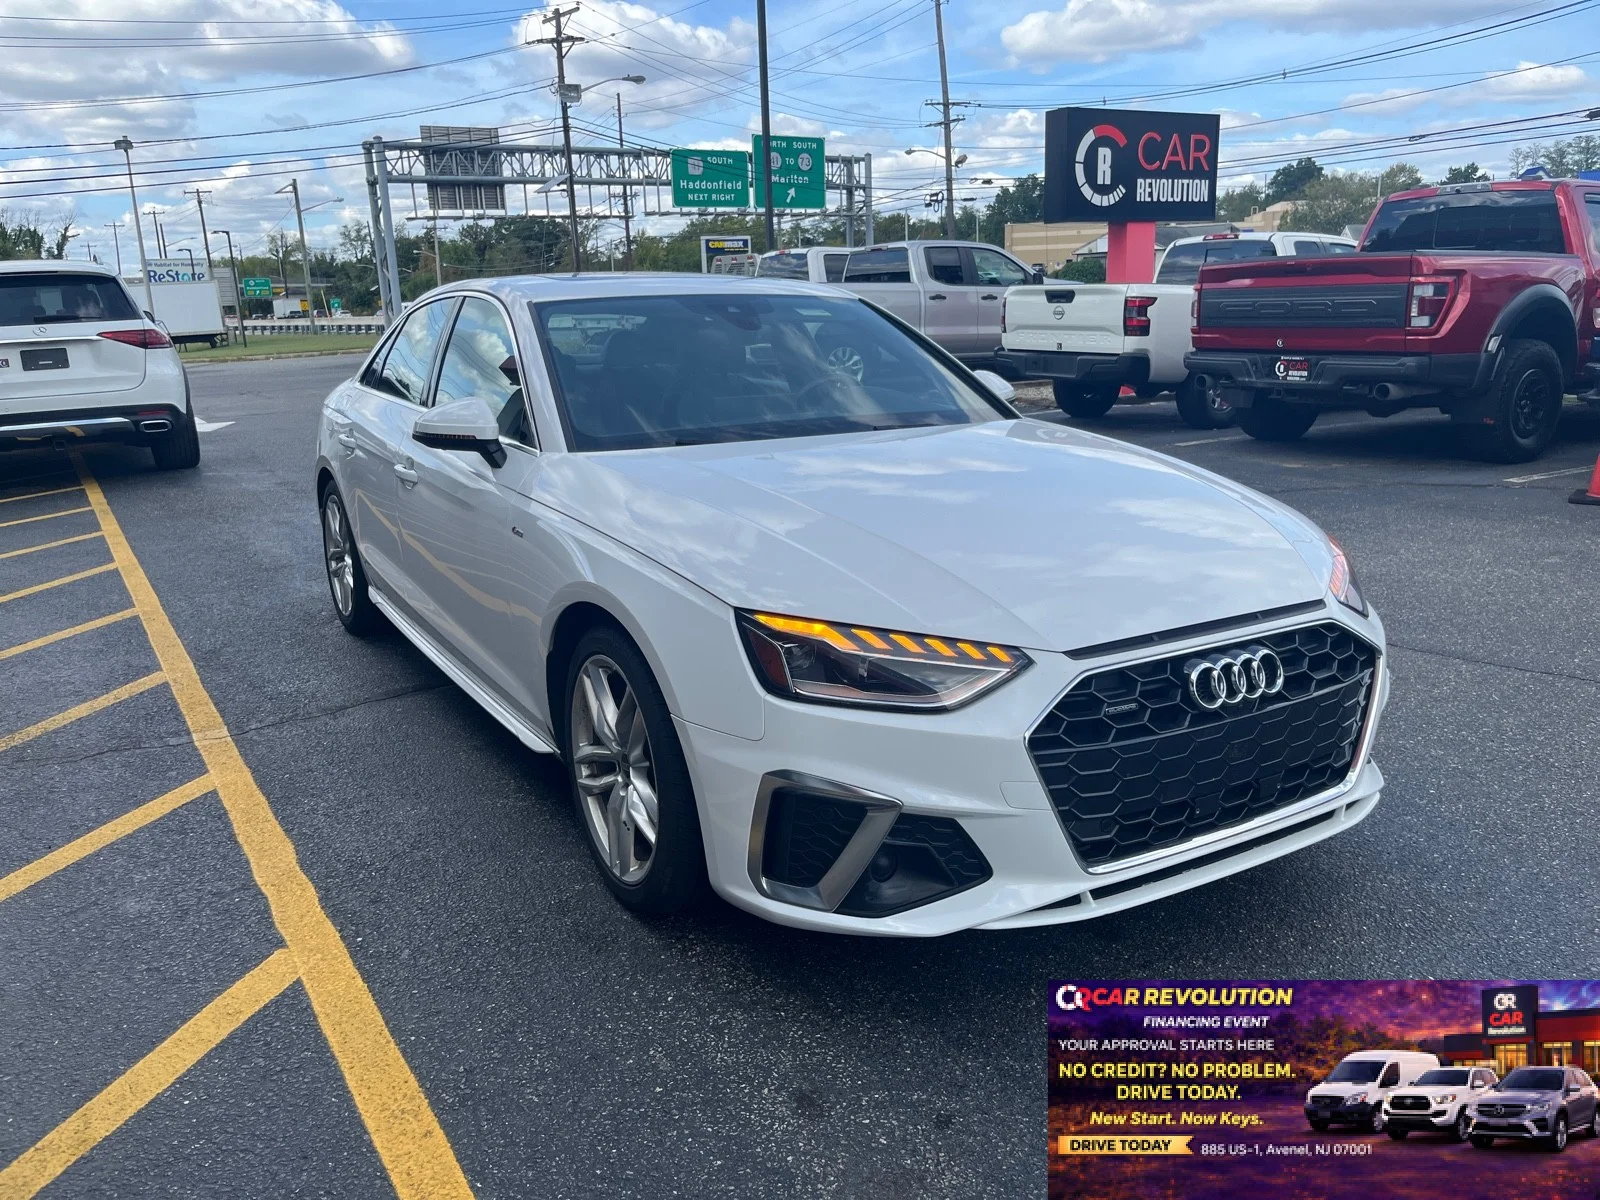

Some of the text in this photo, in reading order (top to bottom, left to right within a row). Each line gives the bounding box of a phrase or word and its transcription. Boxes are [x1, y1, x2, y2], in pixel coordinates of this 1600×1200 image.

[1137, 131, 1211, 172] CAR
[707, 157, 733, 165] SOUTH
[799, 157, 811, 167] 73
[680, 180, 742, 190] Haddonfield
[1136, 178, 1209, 202] REVOLUTION
[147, 270, 206, 283] ReStore
[1219, 299, 1377, 314] FORD
